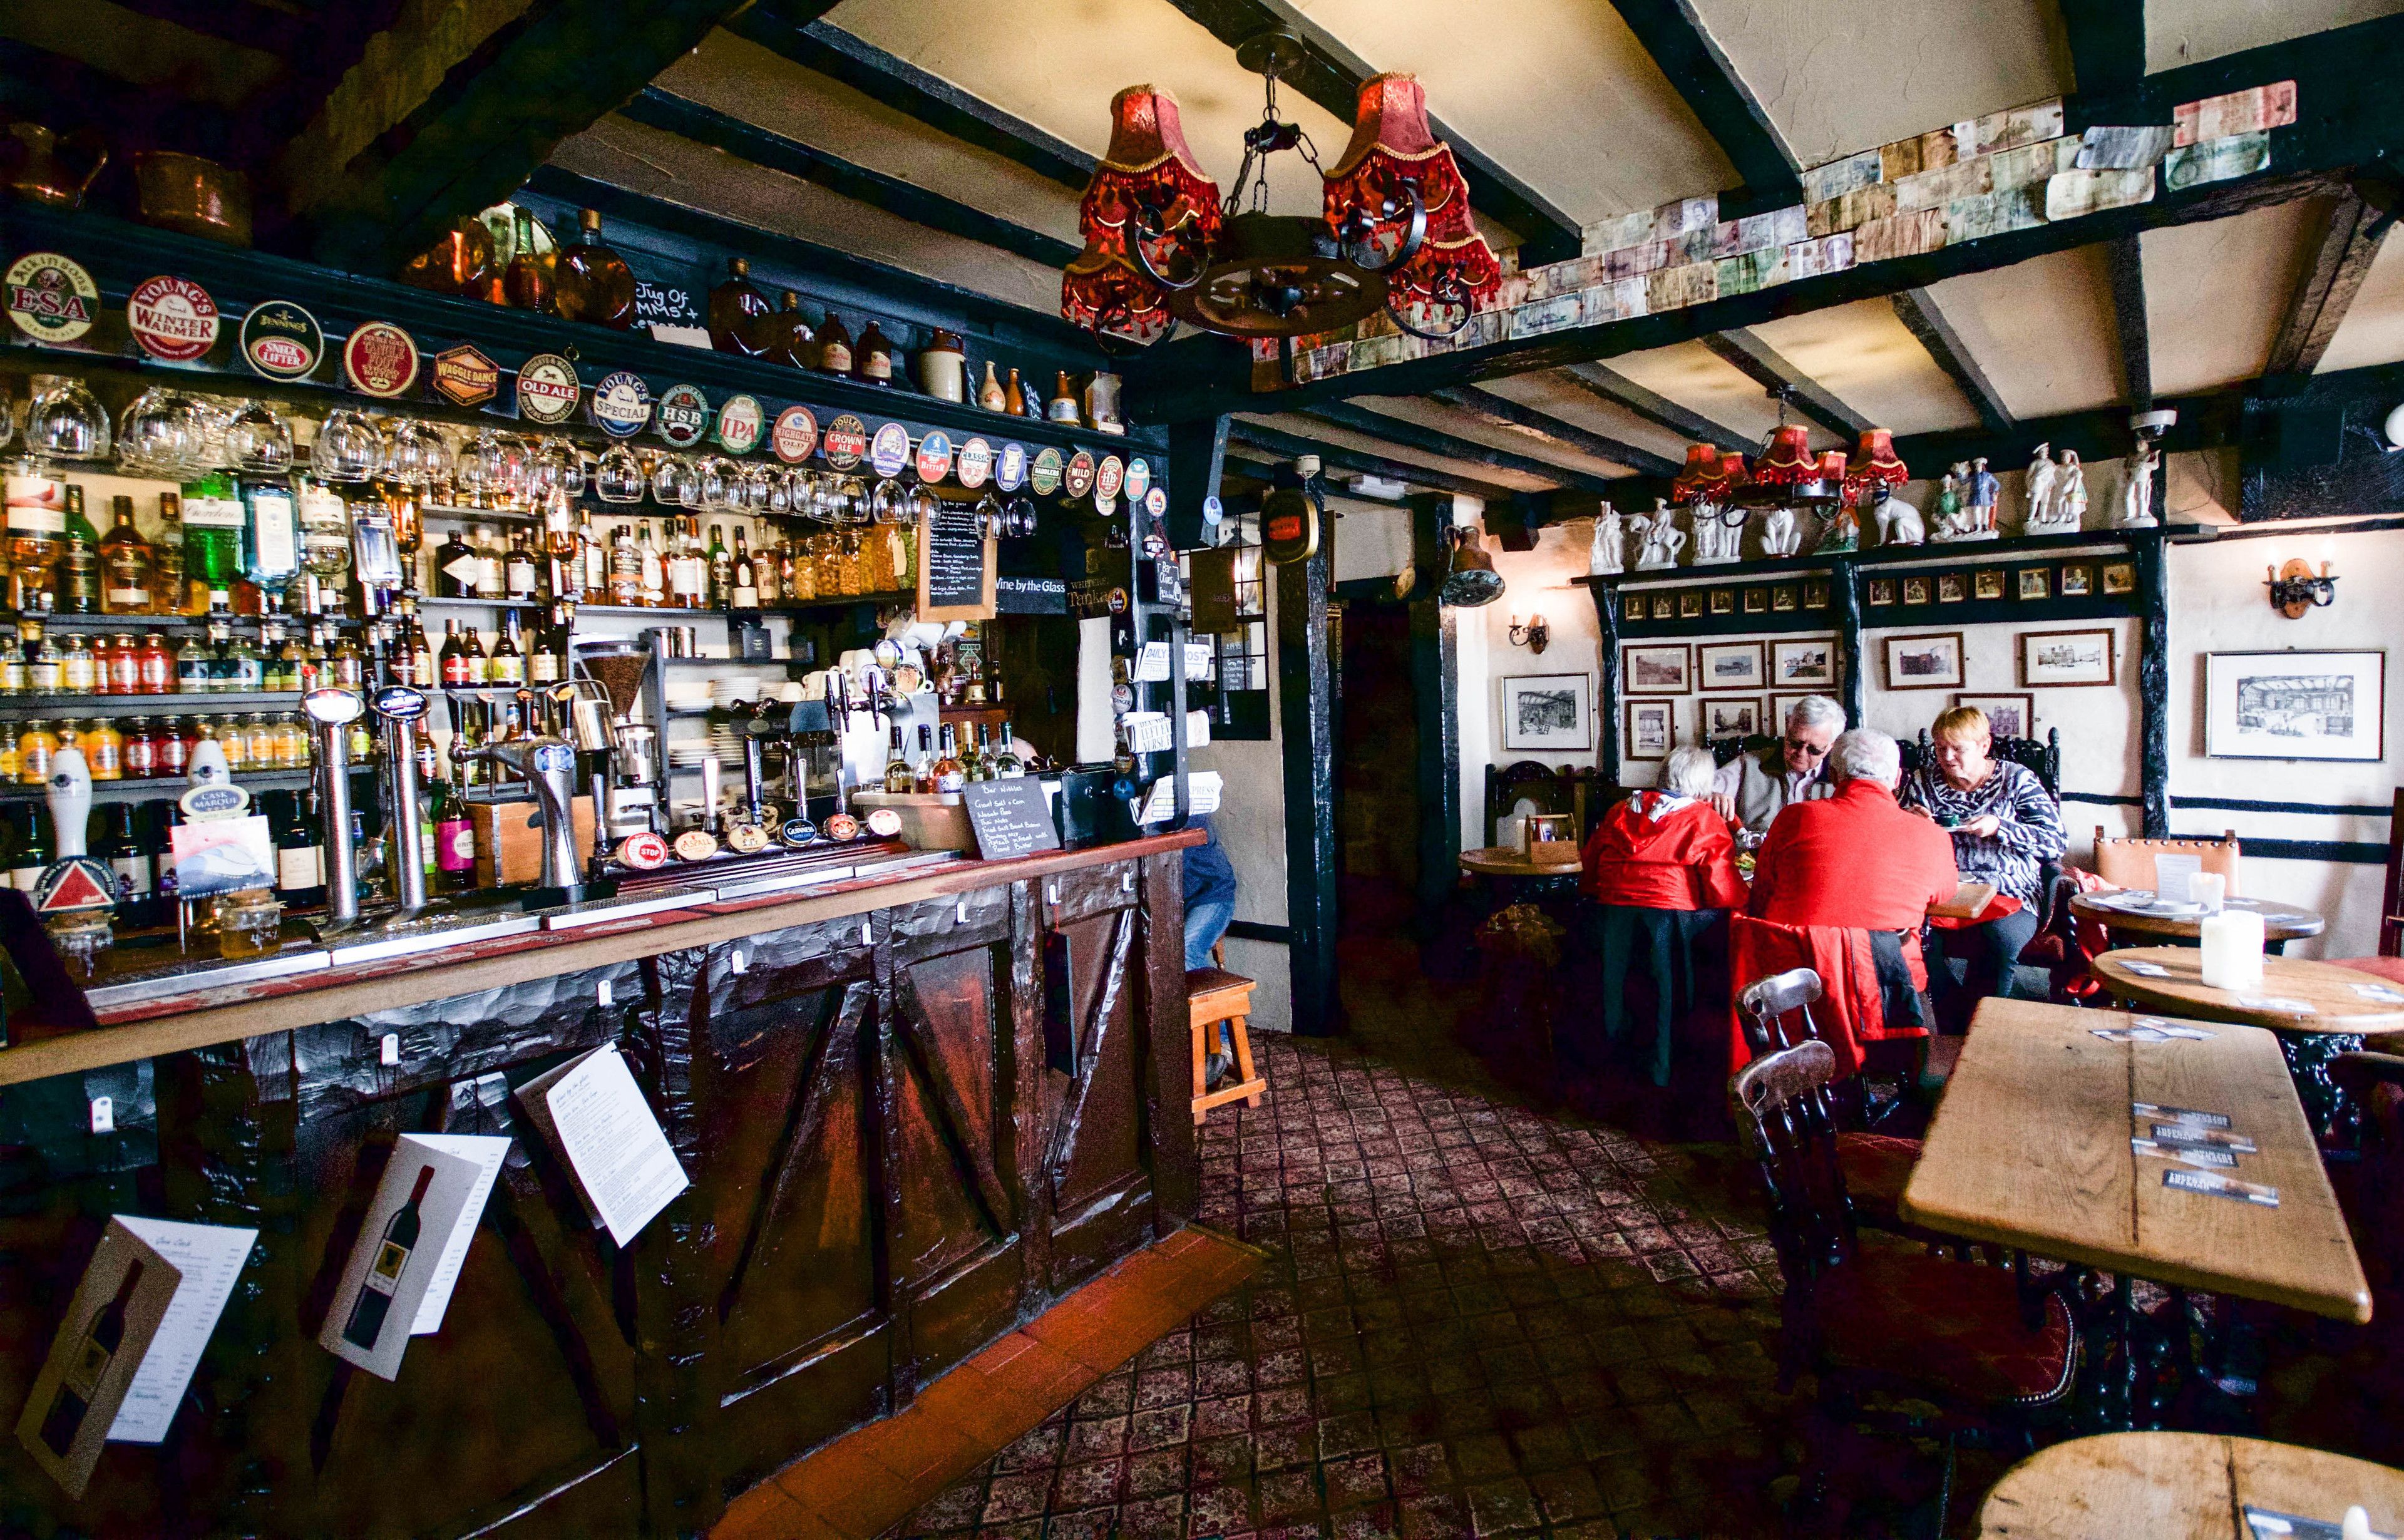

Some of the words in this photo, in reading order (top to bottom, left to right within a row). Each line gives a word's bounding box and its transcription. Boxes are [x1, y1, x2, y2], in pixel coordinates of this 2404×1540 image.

[138, 280, 212, 313] YOUNG'S
[635, 281, 664, 307] Jug
[668, 289, 689, 309] Of
[11, 285, 90, 321] ESA
[635, 301, 681, 317] MMS
[136, 306, 212, 332] WINTER
[263, 351, 300, 366] LIFTER
[438, 362, 471, 380] WAGGLE
[473, 371, 498, 382] DANCE
[522, 381, 549, 394] OLD
[551, 386, 575, 399] ALE
[597, 374, 649, 401] YOUNG'S
[596, 401, 645, 418] SPECIAL
[662, 406, 702, 426] HSB
[721, 417, 756, 443] IPA
[835, 418, 861, 433] JOULE'S
[775, 427, 815, 443] HIGHGATE
[829, 433, 863, 446] CROWN
[836, 444, 852, 452] ALE
[961, 451, 990, 463] CLASSIC
[920, 461, 945, 472] BITTER
[1071, 467, 1090, 478] MILD
[1015, 579, 1027, 593] by
[1027, 579, 1041, 591] the
[1042, 580, 1066, 593] Glass
[1146, 648, 1167, 659] DAILY
[1184, 651, 1205, 662] OST
[1114, 697, 1131, 706] DINGER
[201, 791, 228, 800] CASK
[982, 784, 996, 794] Bar
[1000, 784, 1022, 793] Nibbles
[786, 826, 814, 835] GUINNESS
[640, 848, 660, 857] STOP
[682, 839, 711, 851] ASPALL
